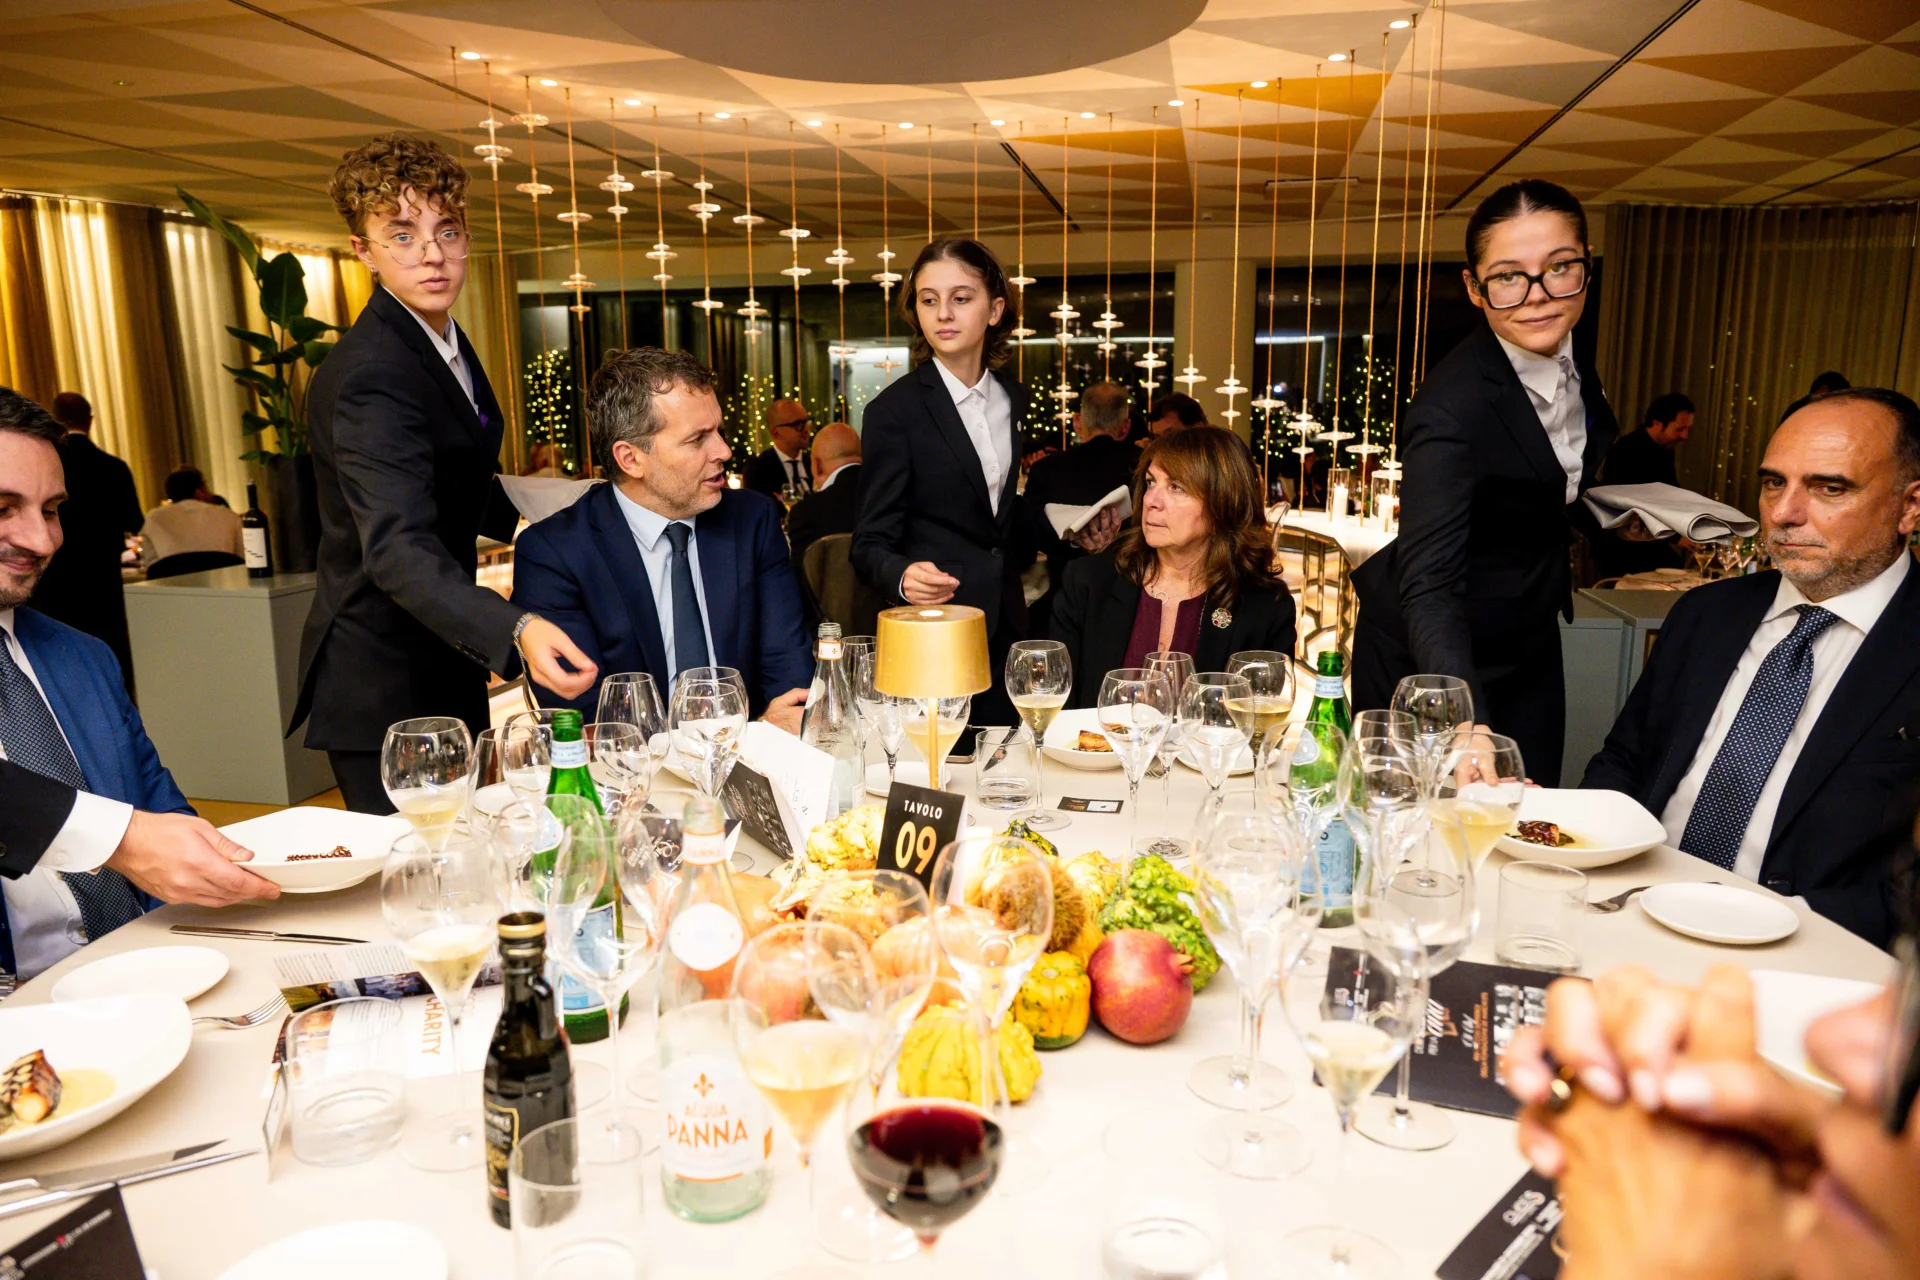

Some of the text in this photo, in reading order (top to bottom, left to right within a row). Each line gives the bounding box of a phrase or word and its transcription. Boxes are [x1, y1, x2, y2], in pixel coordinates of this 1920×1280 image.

[903, 799, 943, 820] TAVOLO
[895, 820, 937, 875] 09
[421, 996, 445, 1055] CHARITY
[666, 1112, 749, 1148] PANNA
